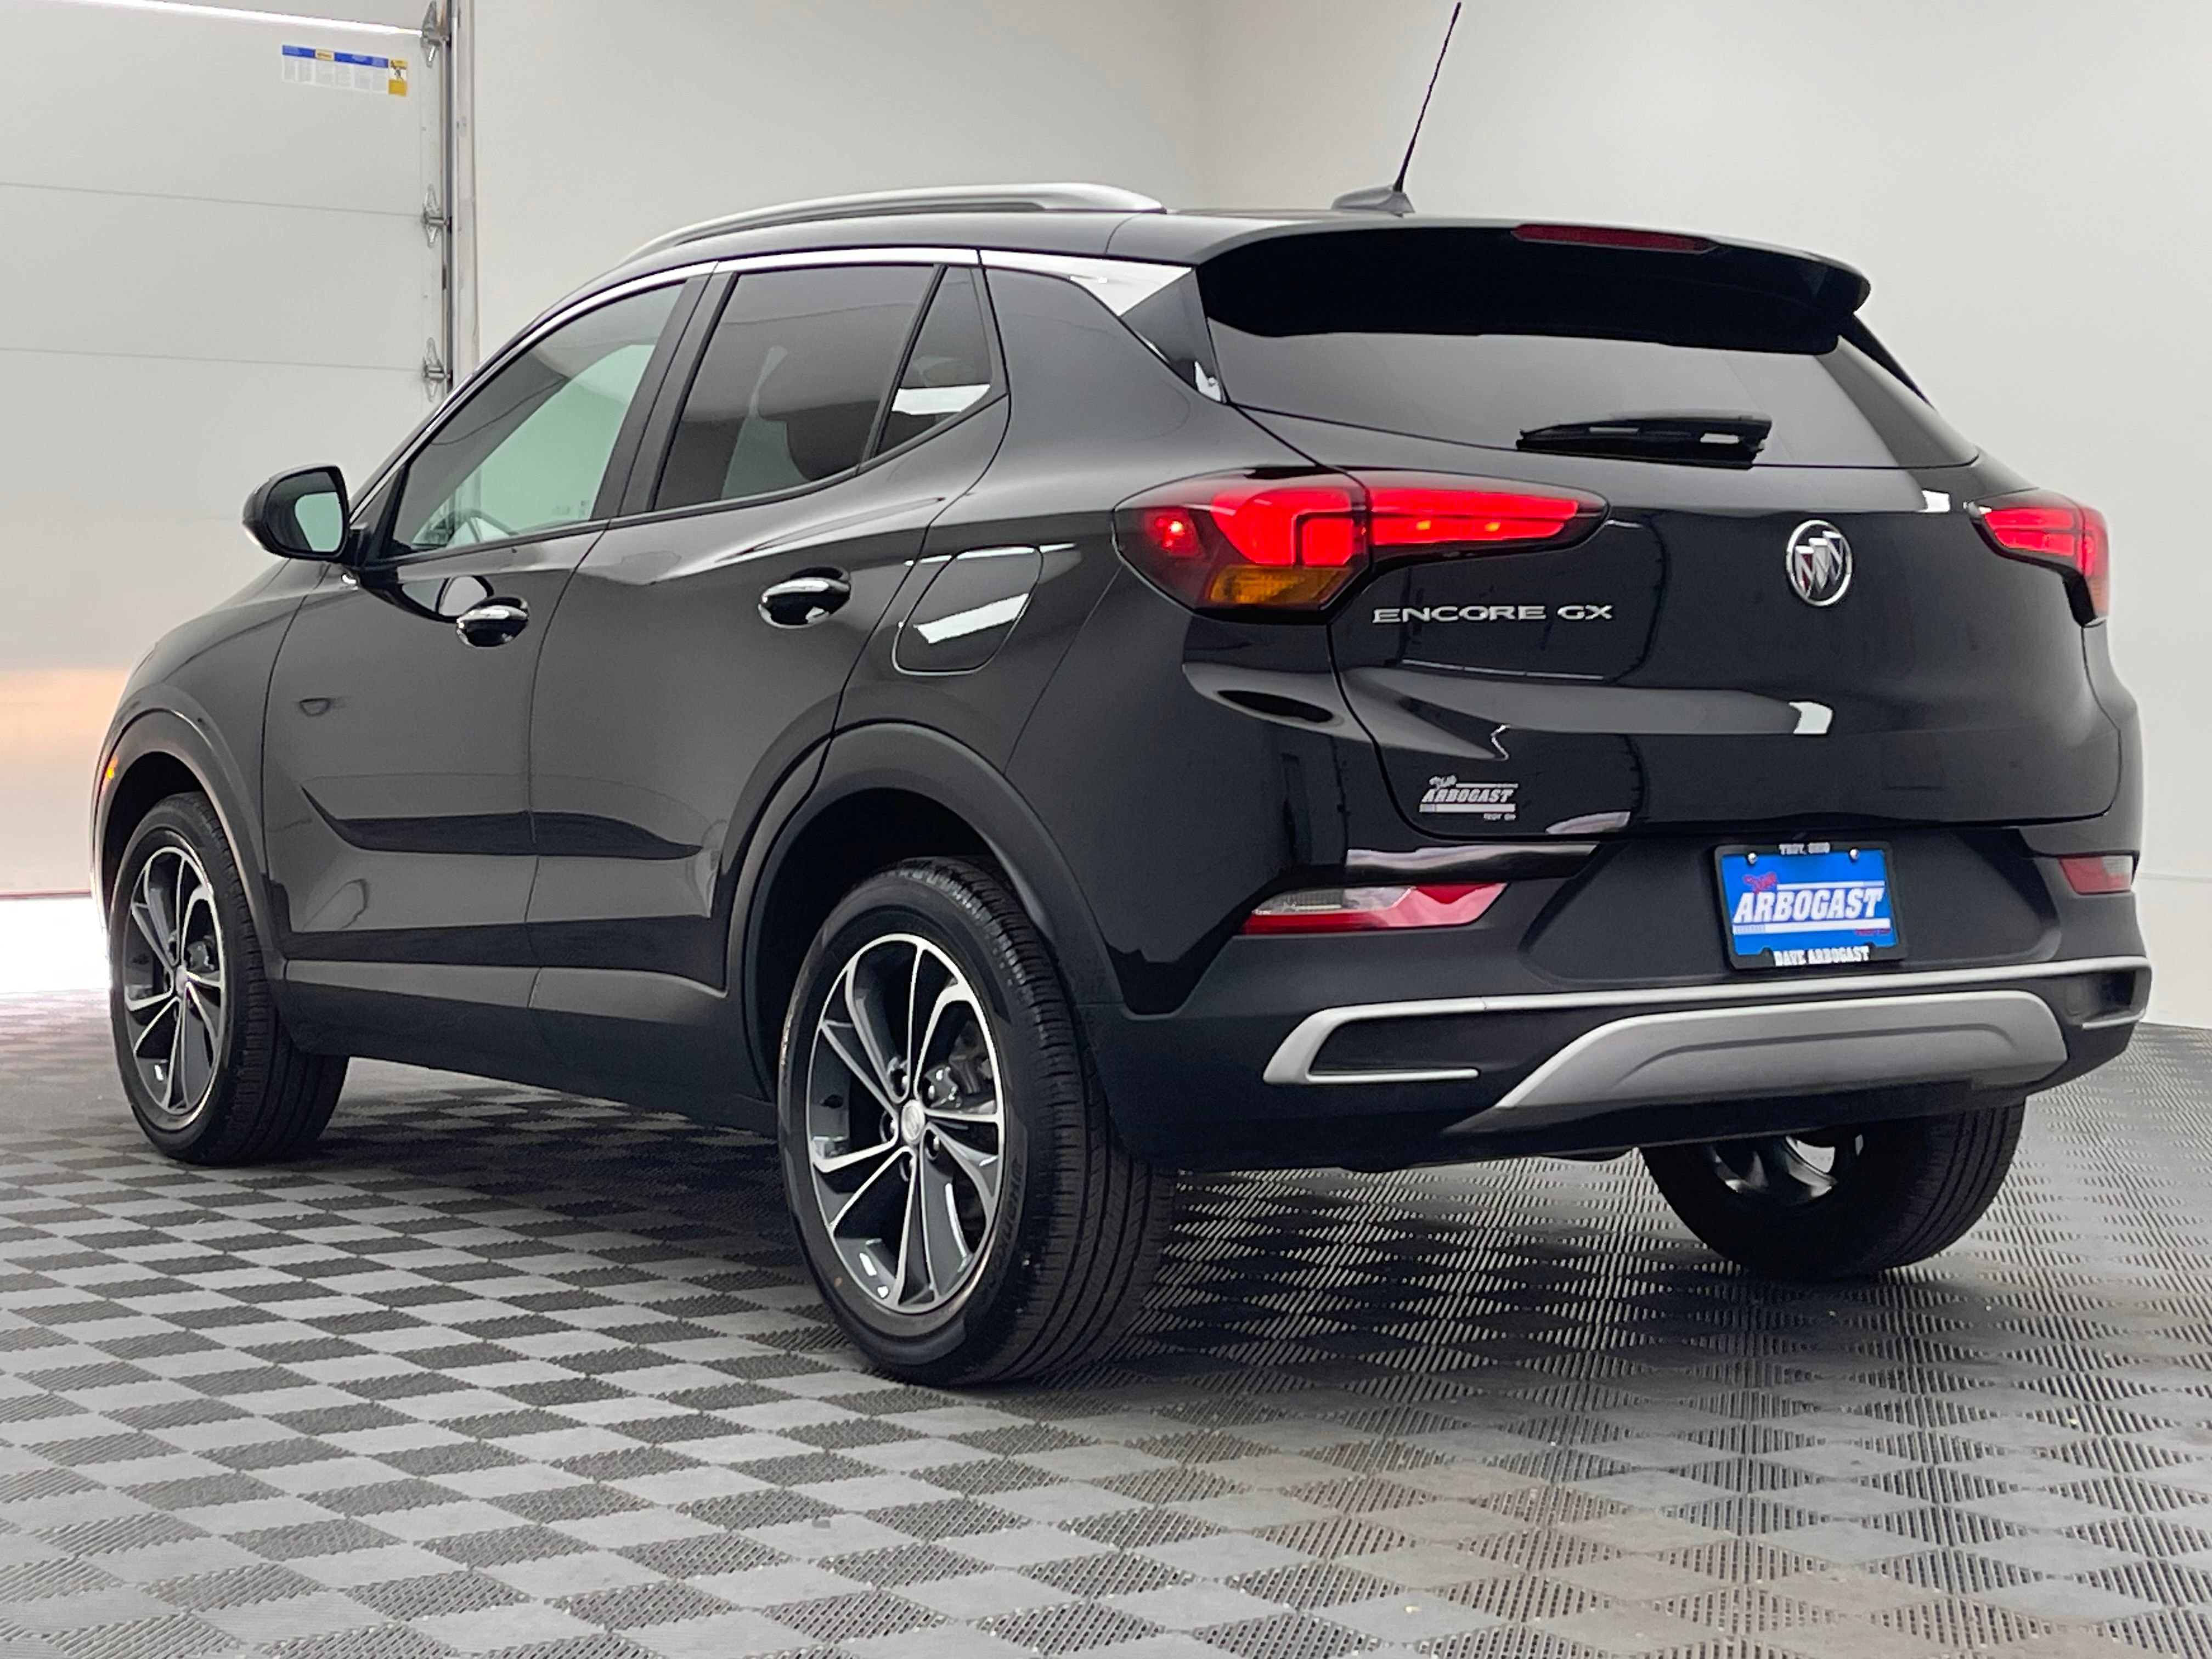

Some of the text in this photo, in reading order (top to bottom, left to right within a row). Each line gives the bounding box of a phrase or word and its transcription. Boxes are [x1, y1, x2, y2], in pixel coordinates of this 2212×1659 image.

[1372, 605, 1613, 623] ENCORE GX
[1421, 788, 1514, 803] ARBOGAST
[1733, 887, 1885, 923] ARBOGAST
